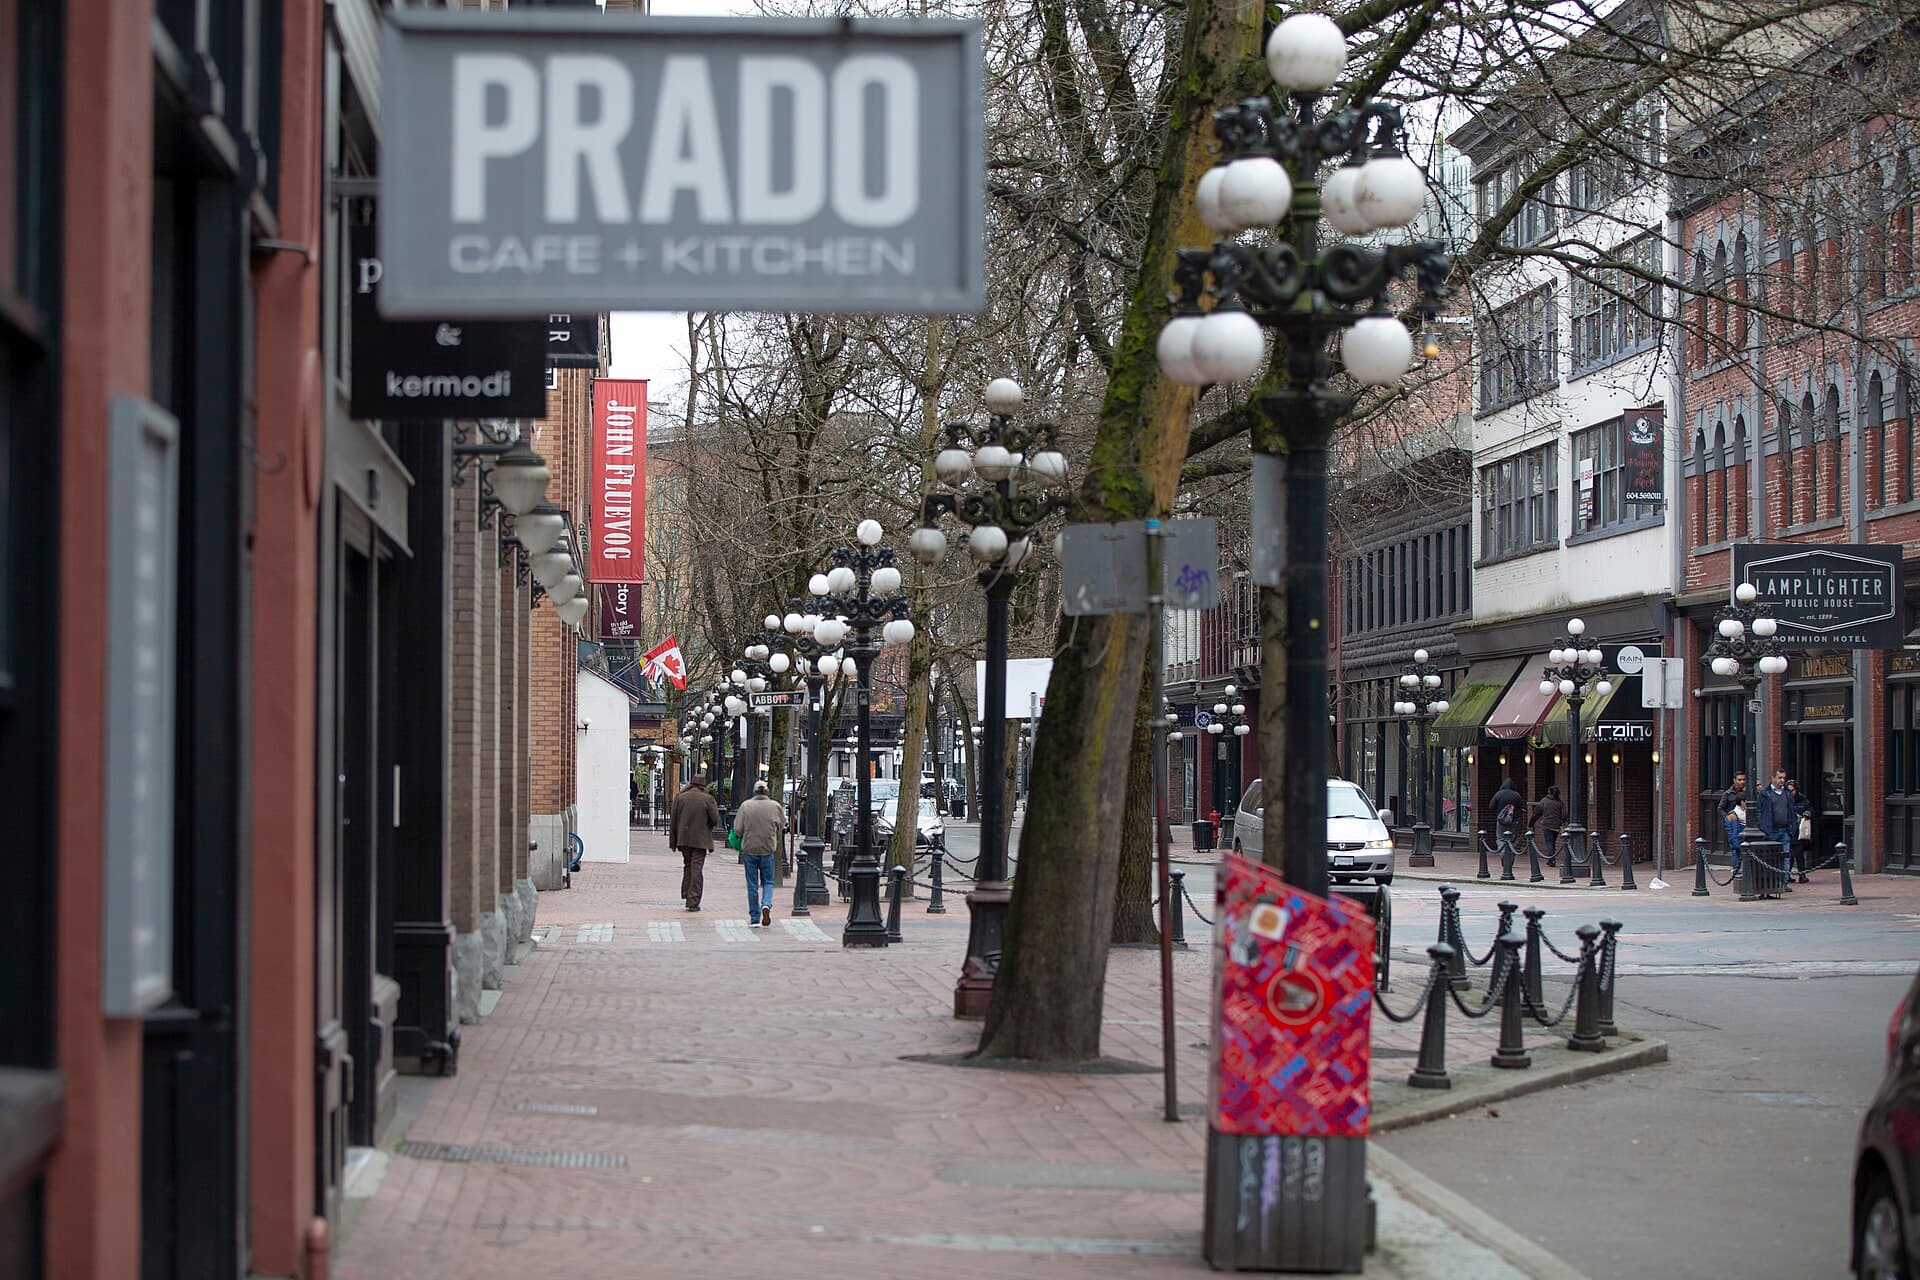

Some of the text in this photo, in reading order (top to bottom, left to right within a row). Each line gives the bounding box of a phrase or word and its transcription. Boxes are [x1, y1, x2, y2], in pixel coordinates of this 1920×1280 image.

[451, 53, 919, 227] PRADO
[449, 235, 600, 274] CAFE
[662, 235, 915, 275] KITCHEN
[386, 370, 512, 398] kermodi
[603, 400, 636, 560] JOHN FLUEVOG
[1811, 567, 1827, 576] THE
[1755, 578, 1883, 596] LAMPLIGHTER
[1785, 598, 1854, 608] PUBLIC HOUSE
[1772, 635, 1867, 643] DOMINION HOTEL
[755, 695, 788, 704] ABBOTT
[1598, 722, 1644, 737] rain
